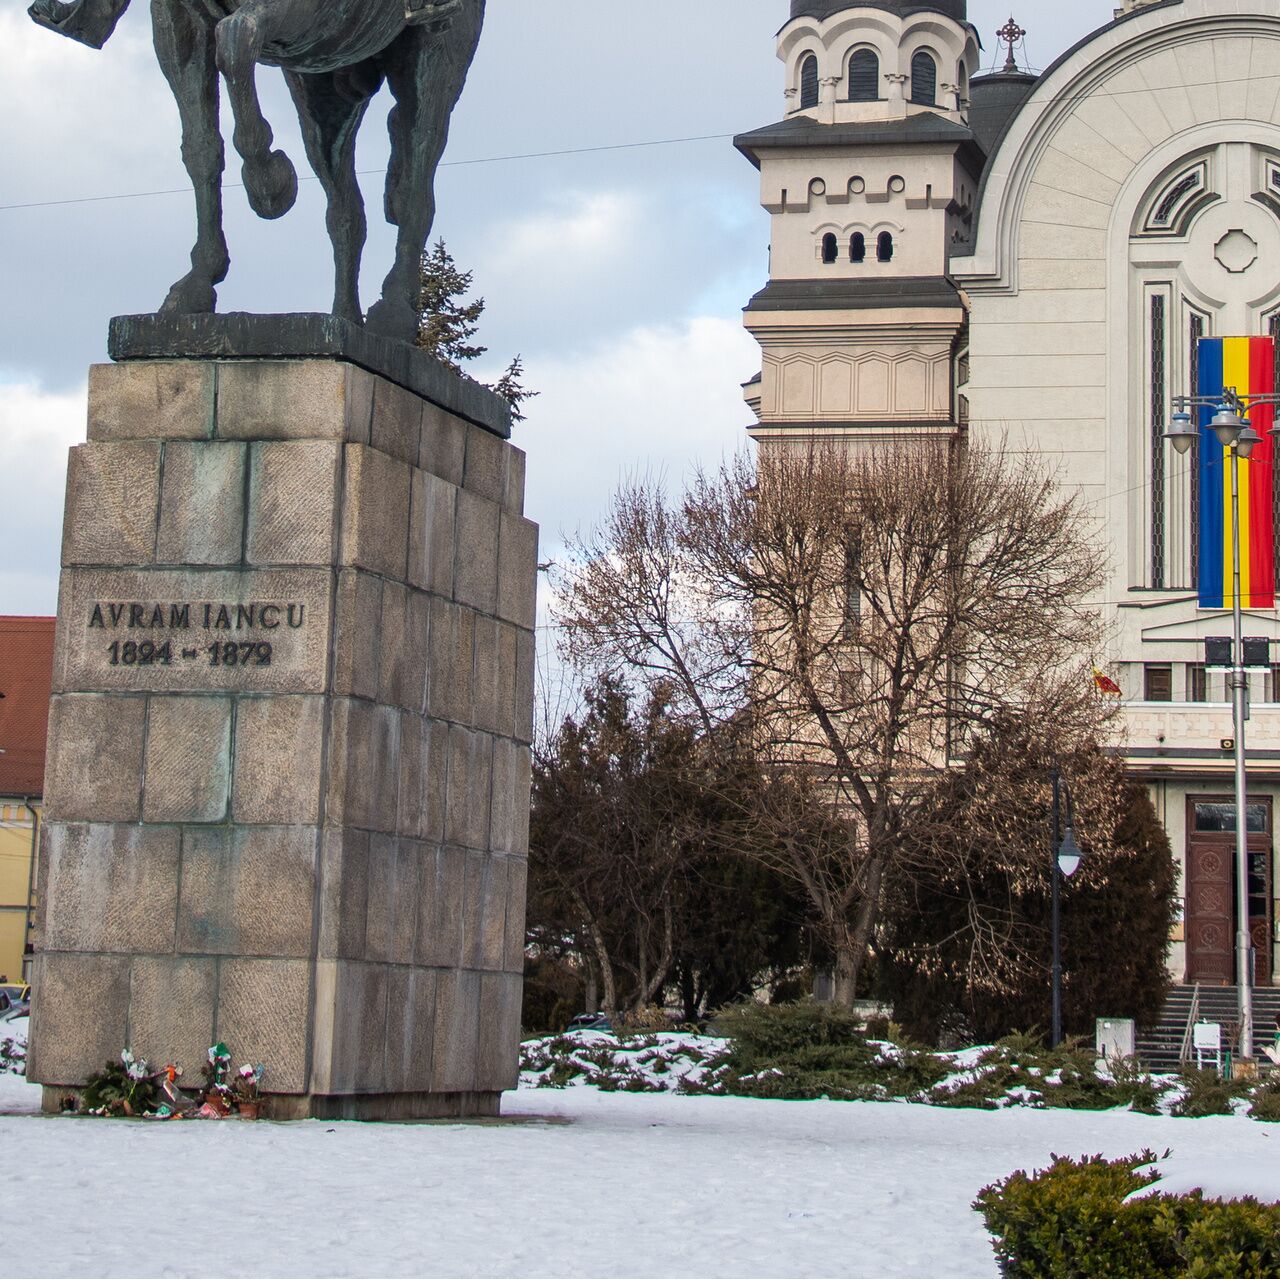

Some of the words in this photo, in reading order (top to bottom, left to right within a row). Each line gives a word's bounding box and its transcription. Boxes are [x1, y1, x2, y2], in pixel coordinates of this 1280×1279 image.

[88, 603, 190, 628] AVRAM
[202, 604, 305, 629] IANCU
[107, 640, 172, 665] 1824
[208, 641, 273, 666] 1872
